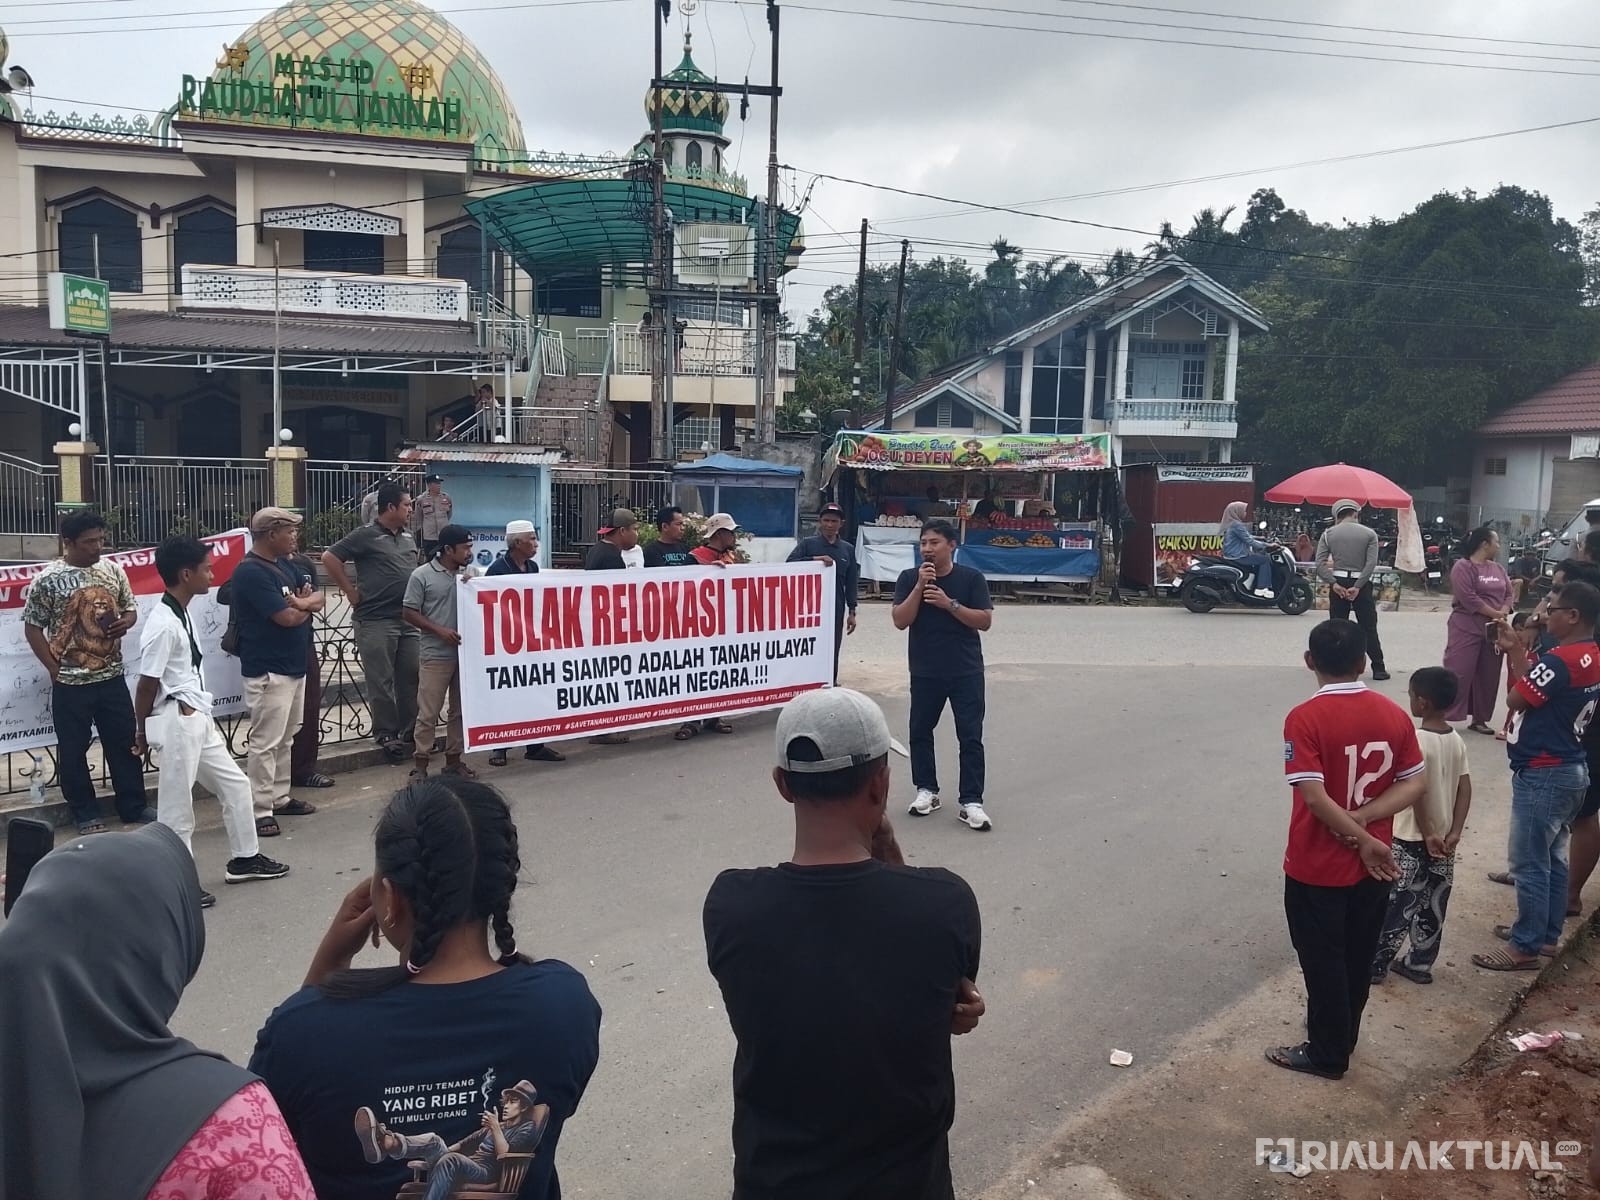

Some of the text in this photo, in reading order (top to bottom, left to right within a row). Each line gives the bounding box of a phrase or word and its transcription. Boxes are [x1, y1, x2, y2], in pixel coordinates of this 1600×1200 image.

[275, 52, 374, 84] MASJID
[182, 73, 462, 134] RAUDHATUL JANNAH
[904, 451, 954, 464] DEYEN
[480, 533, 499, 542] Boba
[477, 574, 822, 656] TOLAK RELOKASI TNTN!!!
[486, 637, 817, 690] TANAH SIAMPO ADALAH TANAH ULAYAT
[1529, 662, 1556, 687] 69
[557, 665, 768, 710] BUKAN TANAH NEGARA.!!!
[478, 723, 561, 740] #TOLAKRELOKASITNTN
[564, 711, 652, 730] #SAVETANAHULAYATSIAMPO
[1344, 742, 1394, 811] 12
[384, 1078, 475, 1095] HIDUP ITU TENANG
[382, 1090, 478, 1113] YANG RIBET
[390, 1108, 467, 1124] ITU MULUT ORANG
